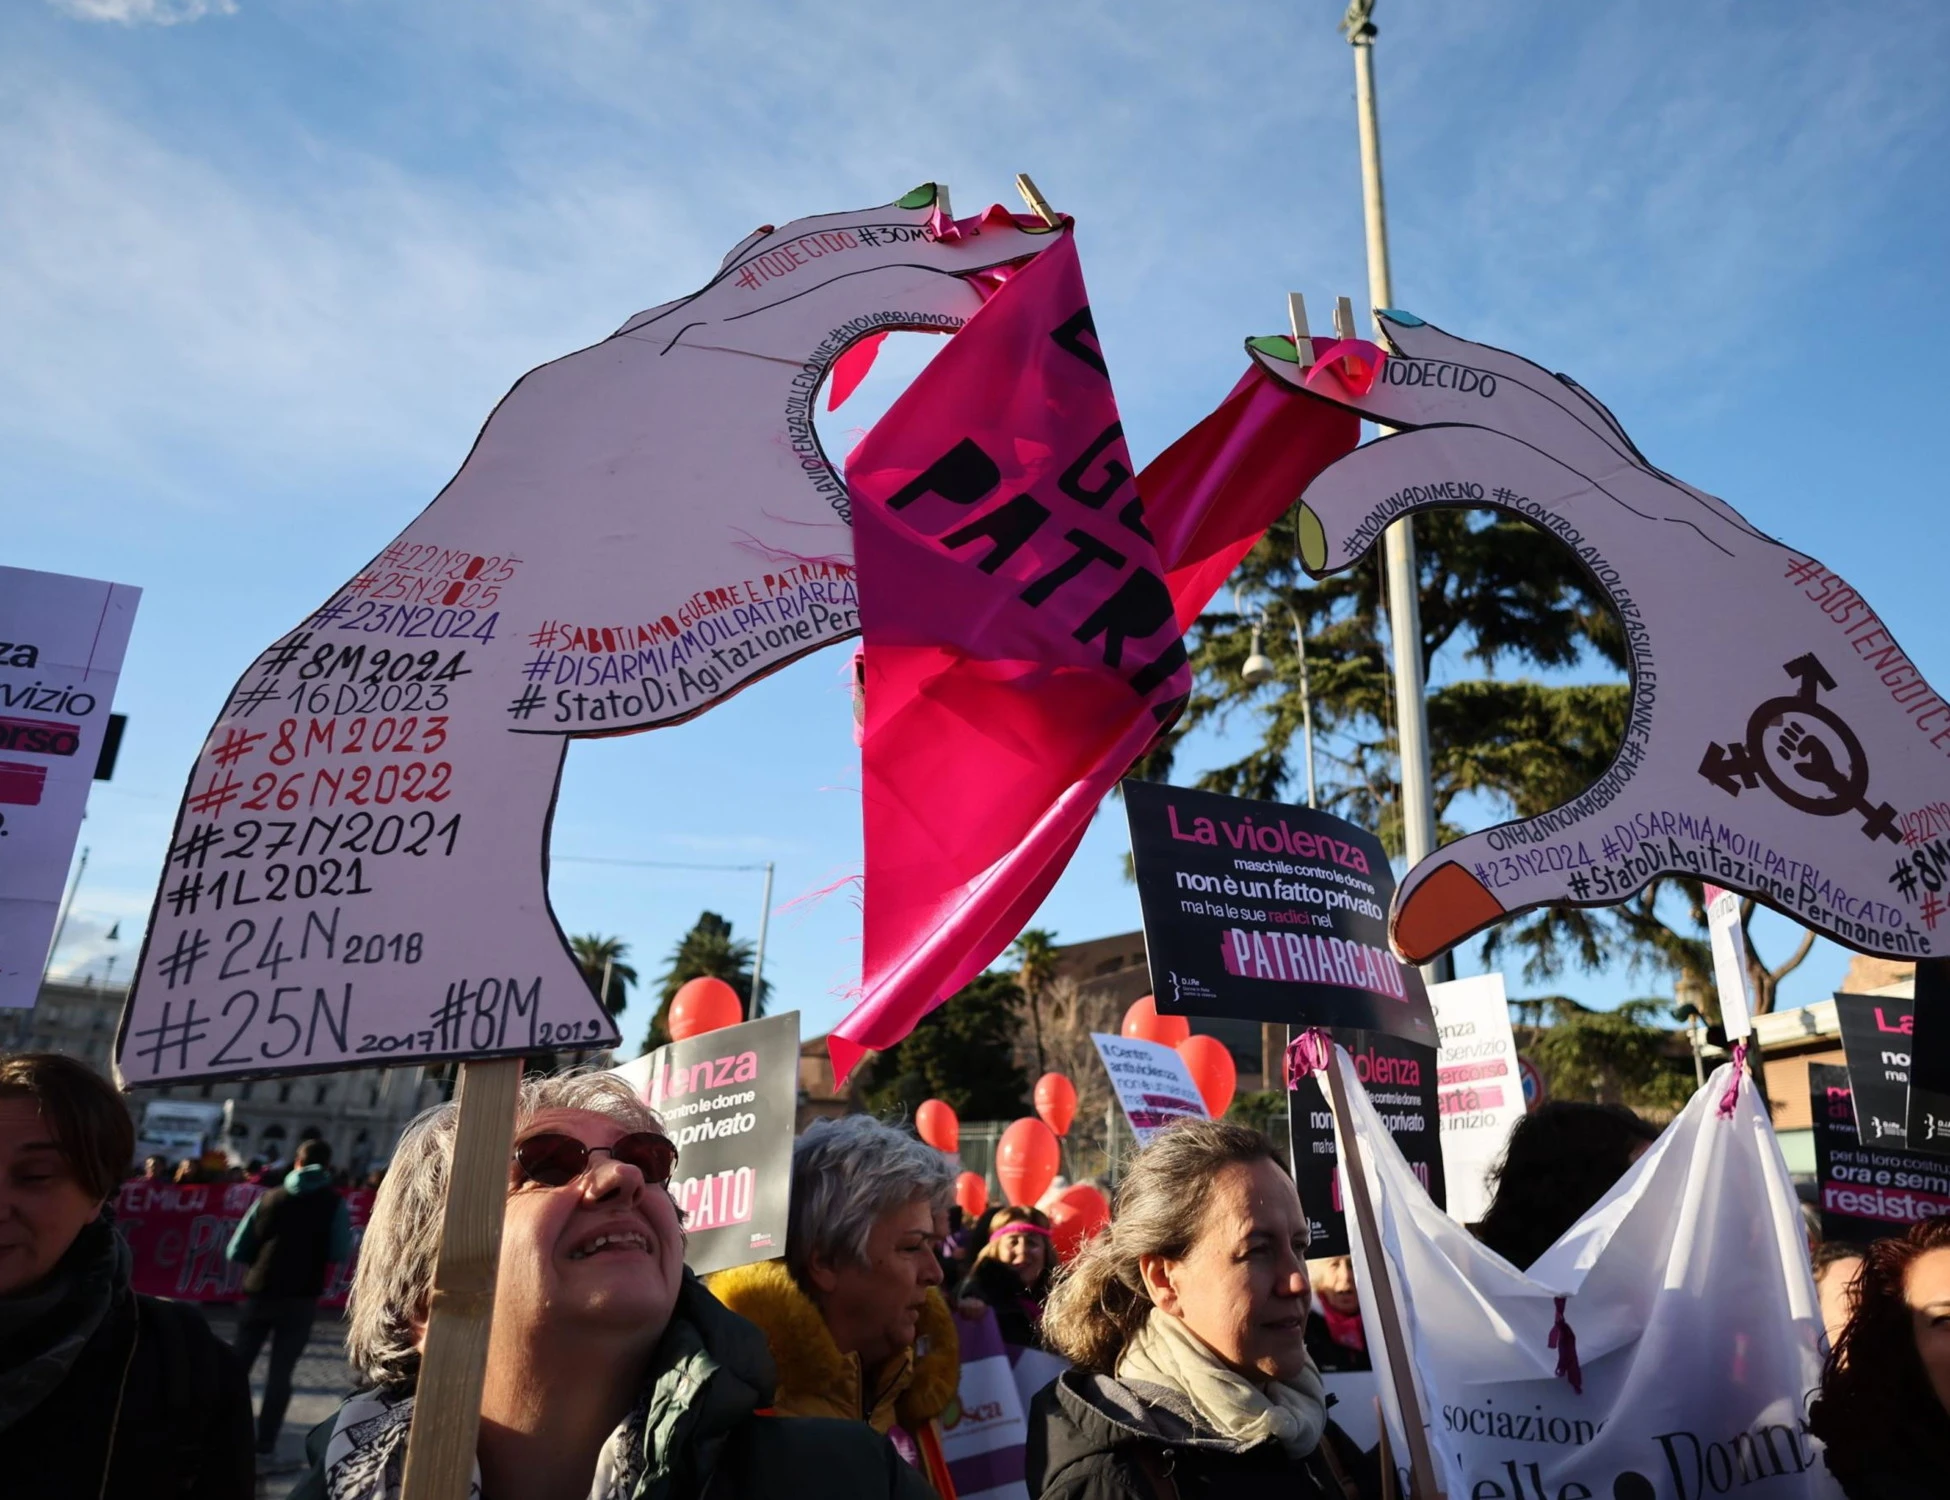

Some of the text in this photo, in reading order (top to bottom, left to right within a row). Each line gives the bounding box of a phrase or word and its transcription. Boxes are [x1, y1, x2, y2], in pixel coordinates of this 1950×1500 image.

[735, 228, 858, 291] #IODECIDO
[1343, 482, 1485, 558] #NONUNADIMENO
[377, 540, 524, 582] #22N2025
[350, 570, 502, 609] #25N2025
[678, 586, 745, 628] GUERRE
[747, 580, 764, 604] E
[310, 595, 500, 646] #23N2024
[260, 632, 472, 684] #8M2024
[231, 677, 449, 718] #16D2023
[190, 762, 453, 819] #26N2022
[172, 811, 463, 869] #27N2021
[1167, 805, 1370, 876] La violenza
[167, 857, 373, 916] #1L2021
[1234, 858, 1375, 895] maschile contro le donne
[1475, 841, 1596, 888] #23N2024
[1601, 810, 1902, 928] #DISARMIAMOILPATRIARCATO
[1175, 871, 1383, 921] non è un fatto privato
[1181, 899, 1334, 929] ma ha le sue radici nel
[1230, 927, 1405, 998] PATRIARCATO
[712, 1090, 756, 1111] donne
[677, 1113, 757, 1153] privato
[1830, 1151, 1852, 1163] per
[1856, 1151, 1869, 1165] la
[1872, 1152, 1900, 1168] loro
[1832, 1165, 1872, 1183] ora
[1875, 1170, 1891, 1186] e
